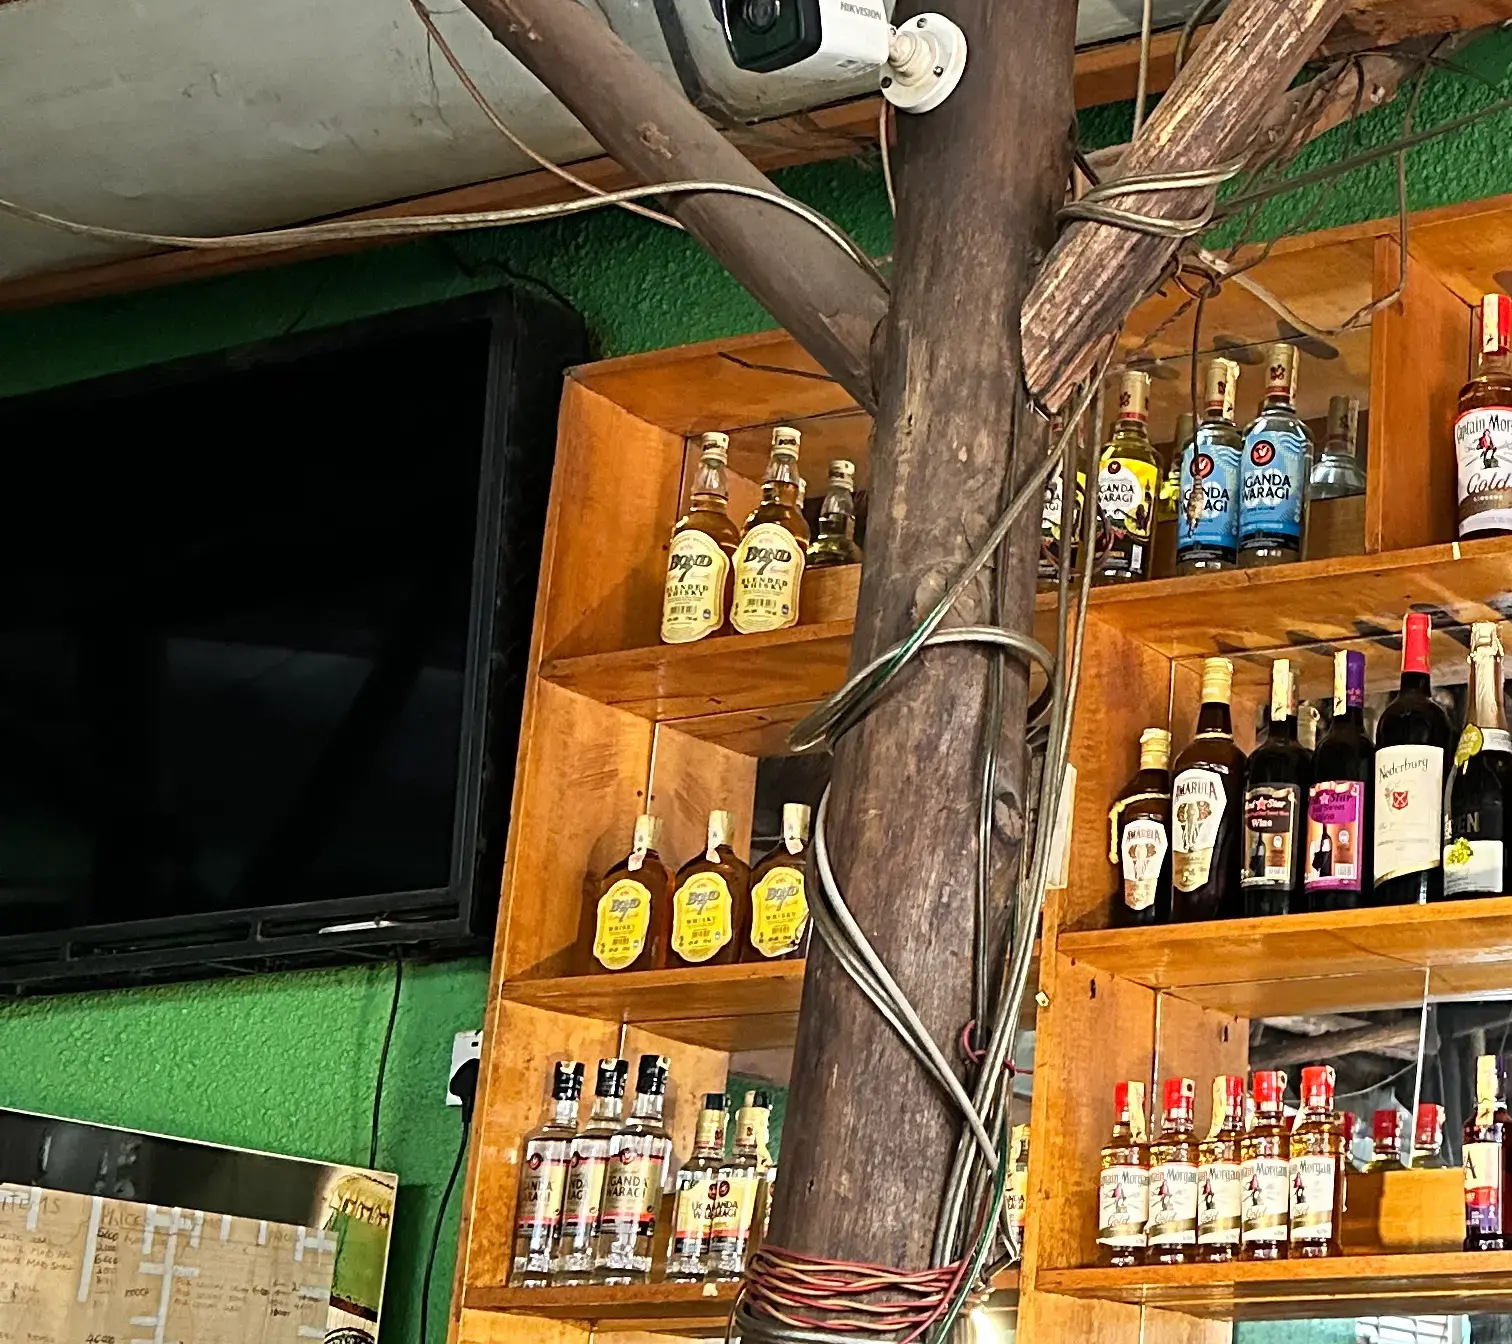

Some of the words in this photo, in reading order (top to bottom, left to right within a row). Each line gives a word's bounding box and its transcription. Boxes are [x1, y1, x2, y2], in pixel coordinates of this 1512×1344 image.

[839, 1, 883, 21] HIKVISION
[1099, 483, 1136, 495] GANDA
[1467, 471, 1512, 495] Gold
[668, 553, 713, 571] BOND
[743, 546, 793, 563] BOND
[741, 577, 789, 587] BLENDED
